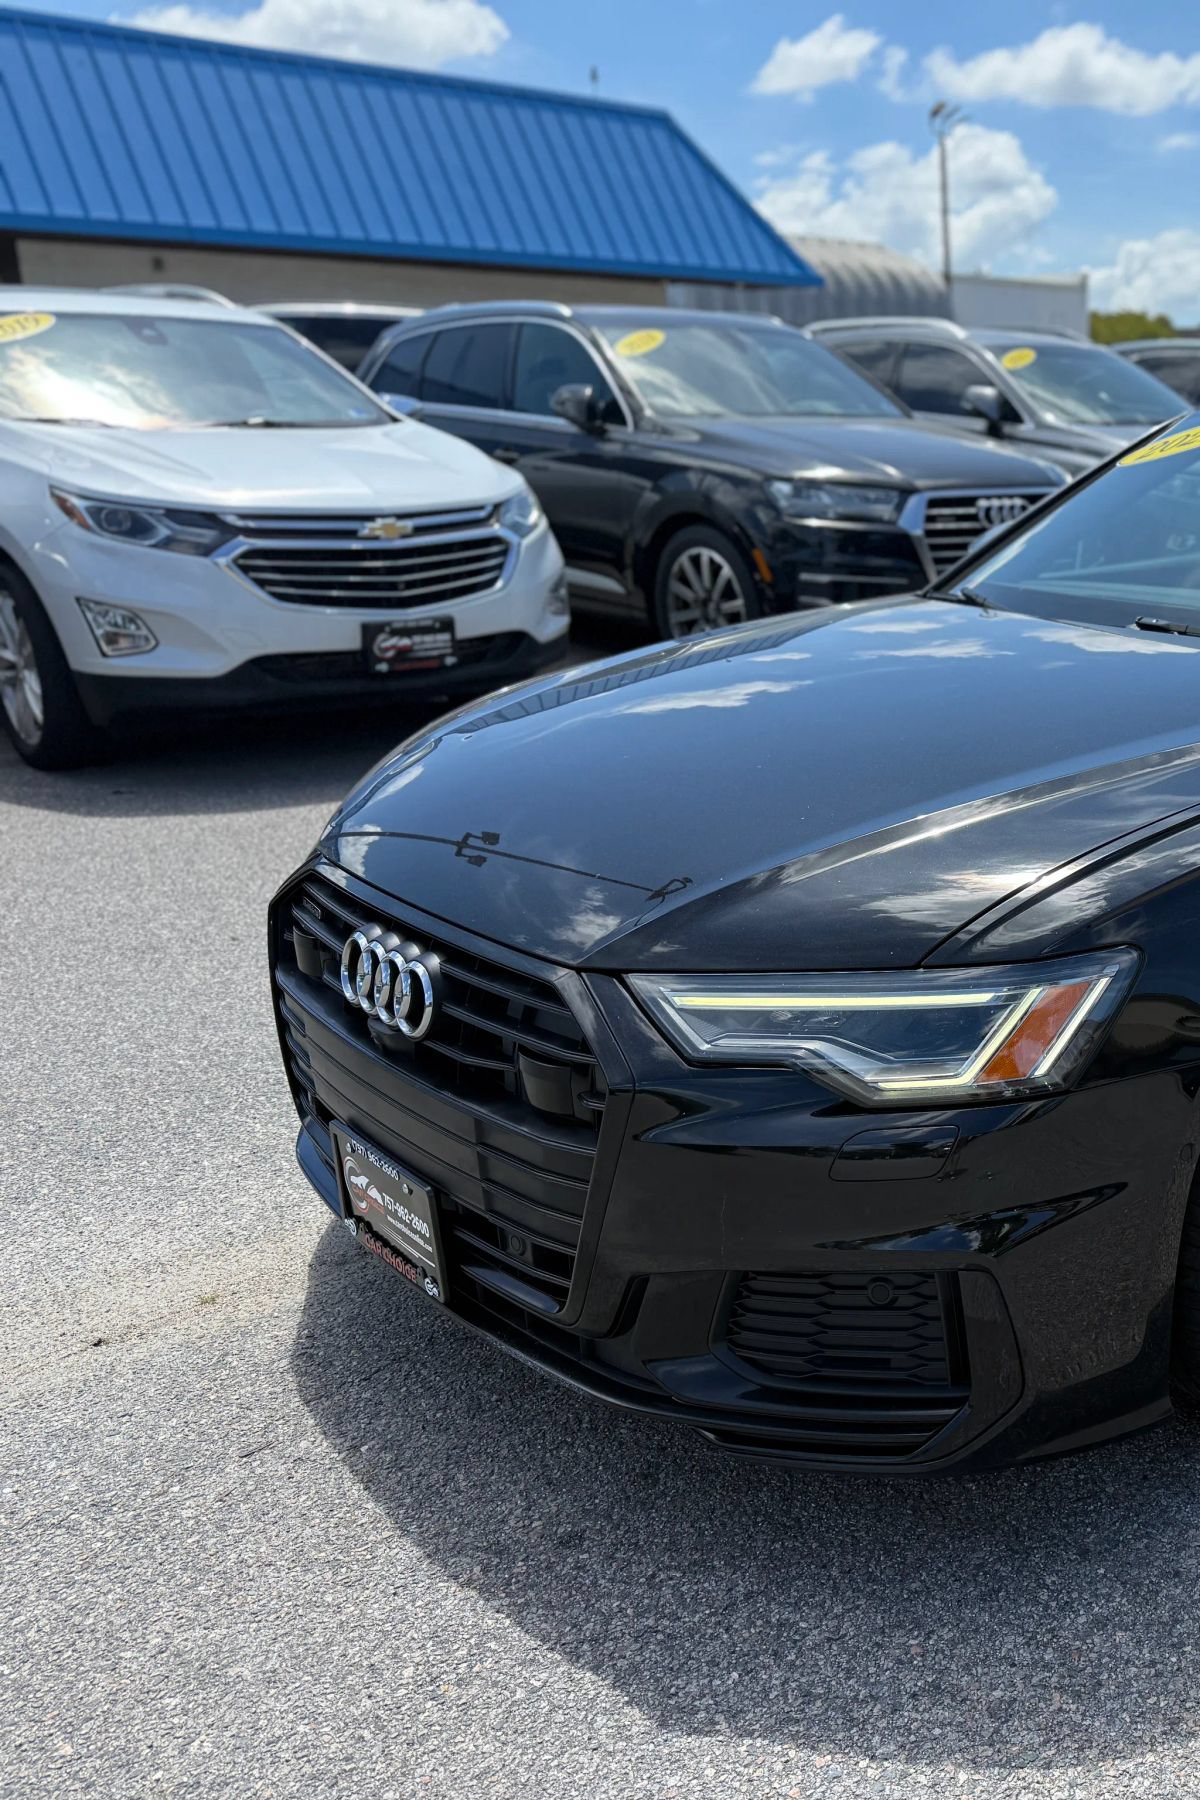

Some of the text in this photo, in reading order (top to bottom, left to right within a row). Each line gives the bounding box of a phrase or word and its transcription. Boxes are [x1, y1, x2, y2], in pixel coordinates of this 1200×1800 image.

[0, 315, 40, 338] 019
[382, 1192, 430, 1238] 757-962-2600
[383, 1247, 417, 1284] CHOICE
